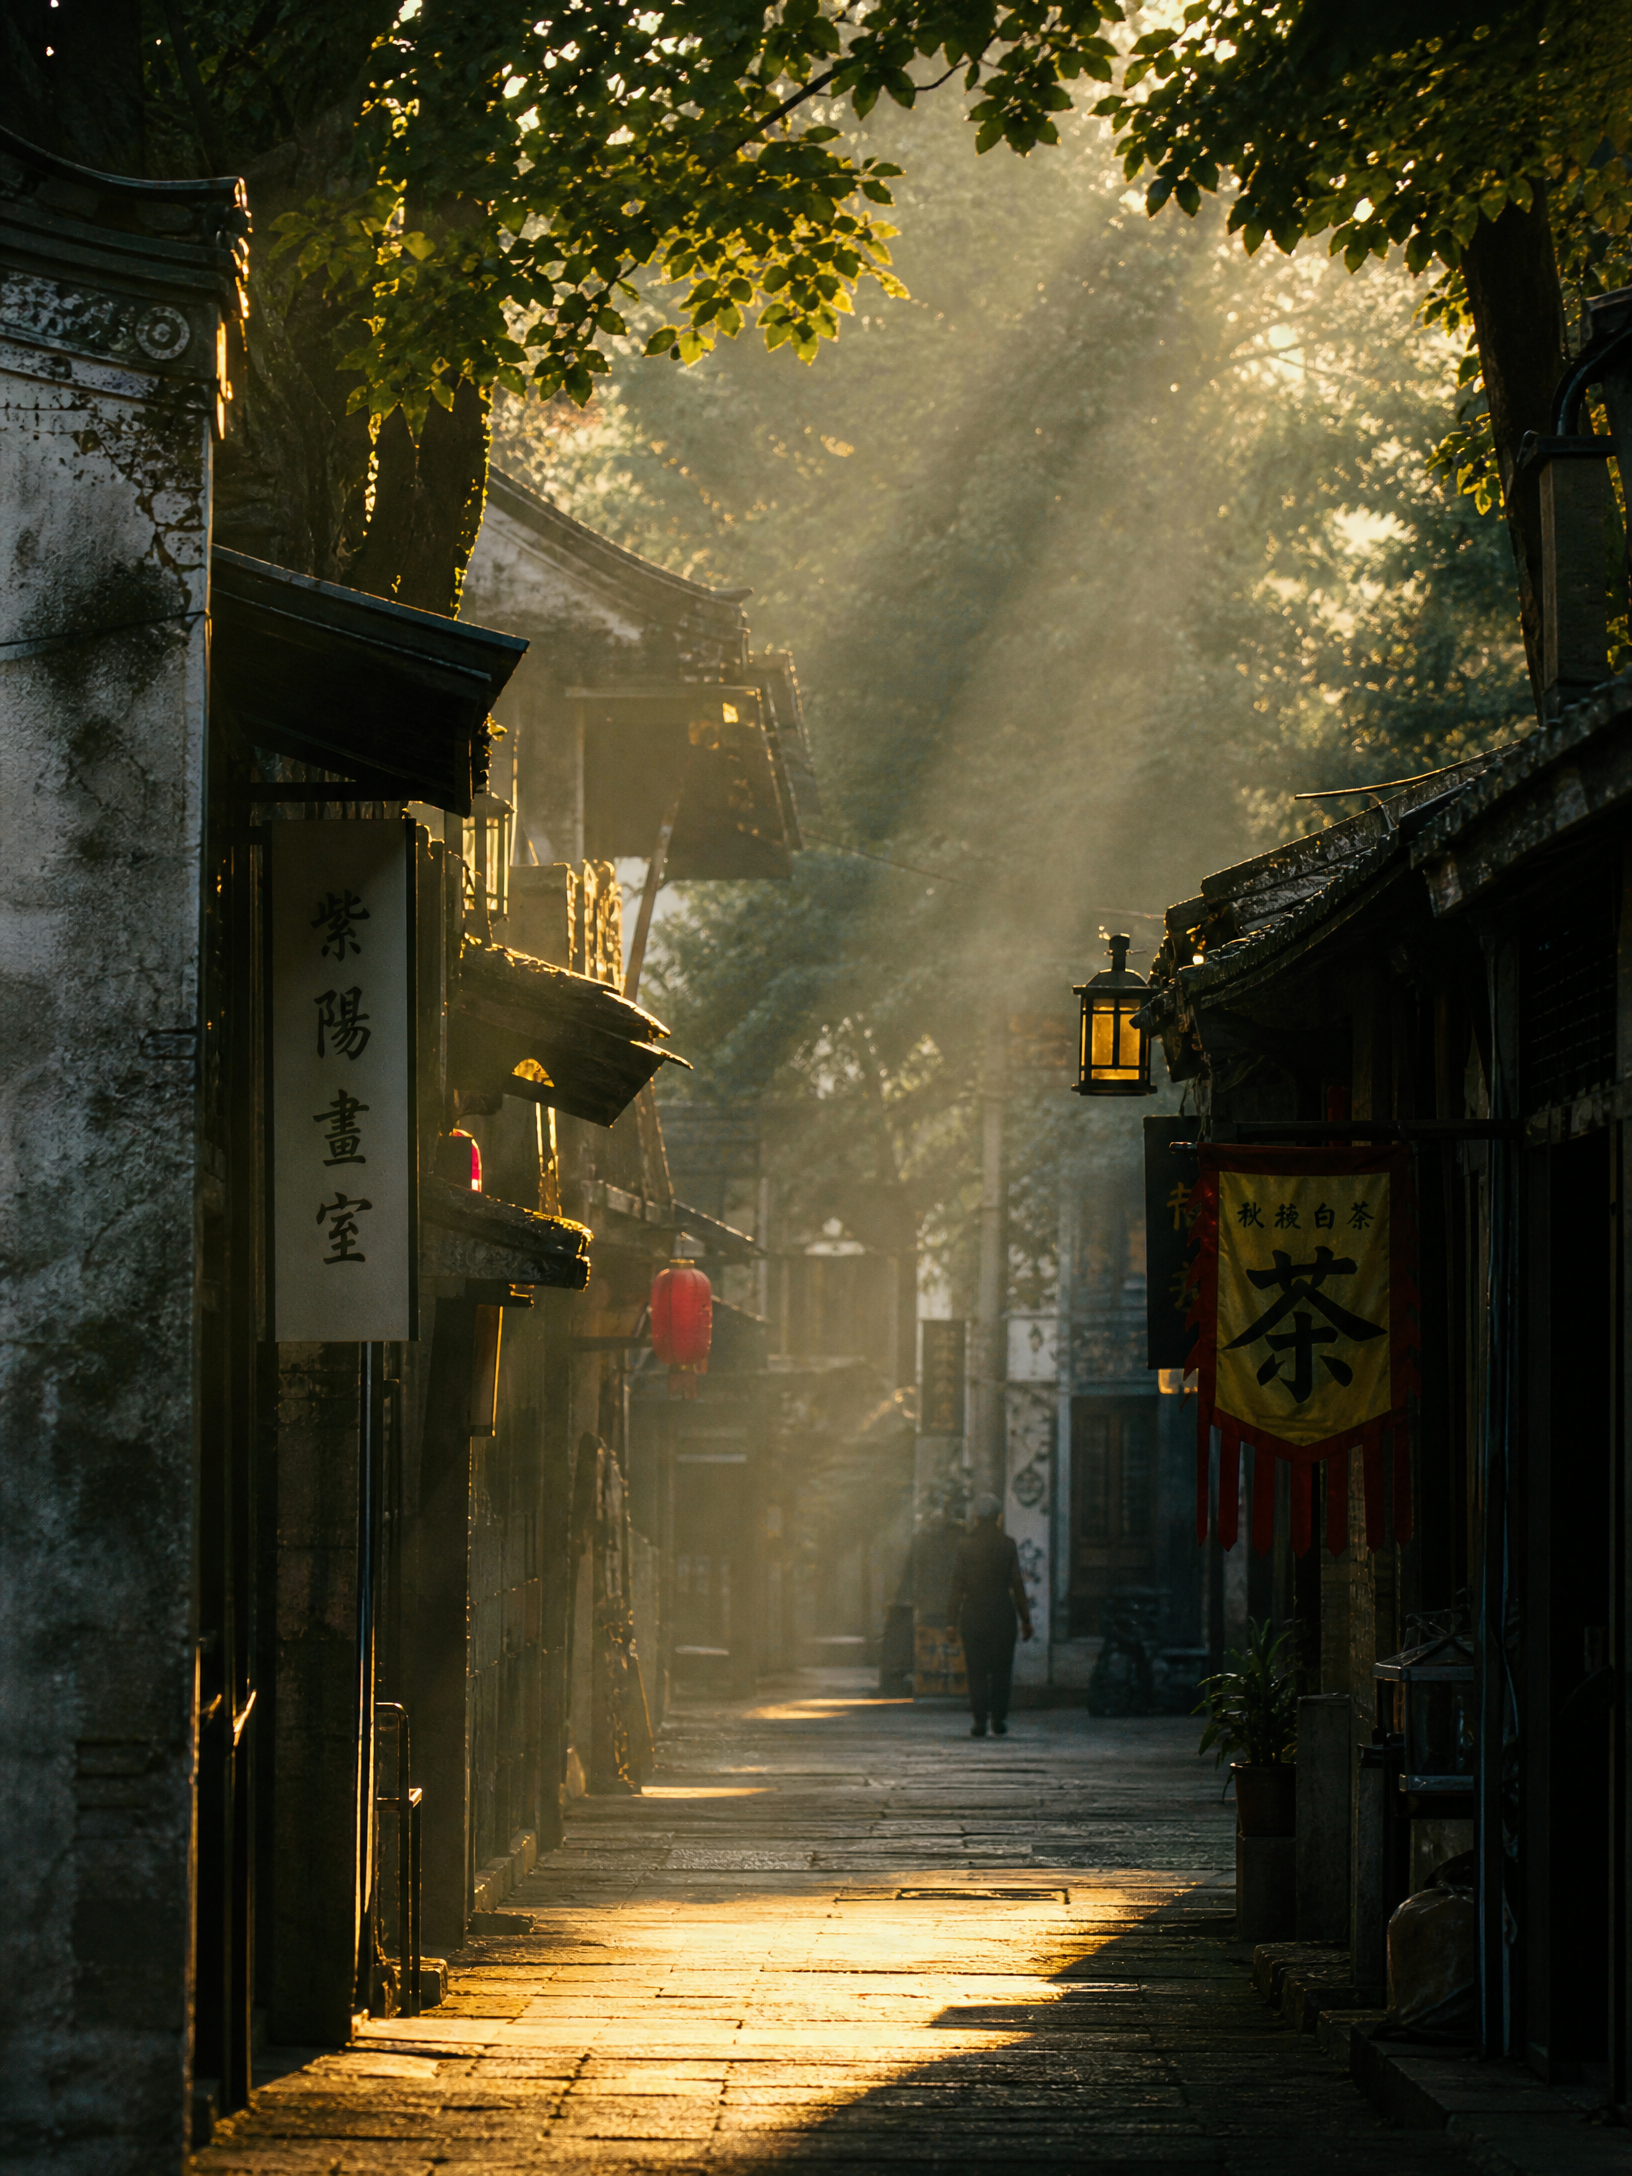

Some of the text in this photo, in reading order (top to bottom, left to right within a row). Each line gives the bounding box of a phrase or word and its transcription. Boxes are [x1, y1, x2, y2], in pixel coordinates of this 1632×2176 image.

[310, 889, 373, 1265] 紫陽畫室
[1222, 1245, 1389, 1404] 茶
